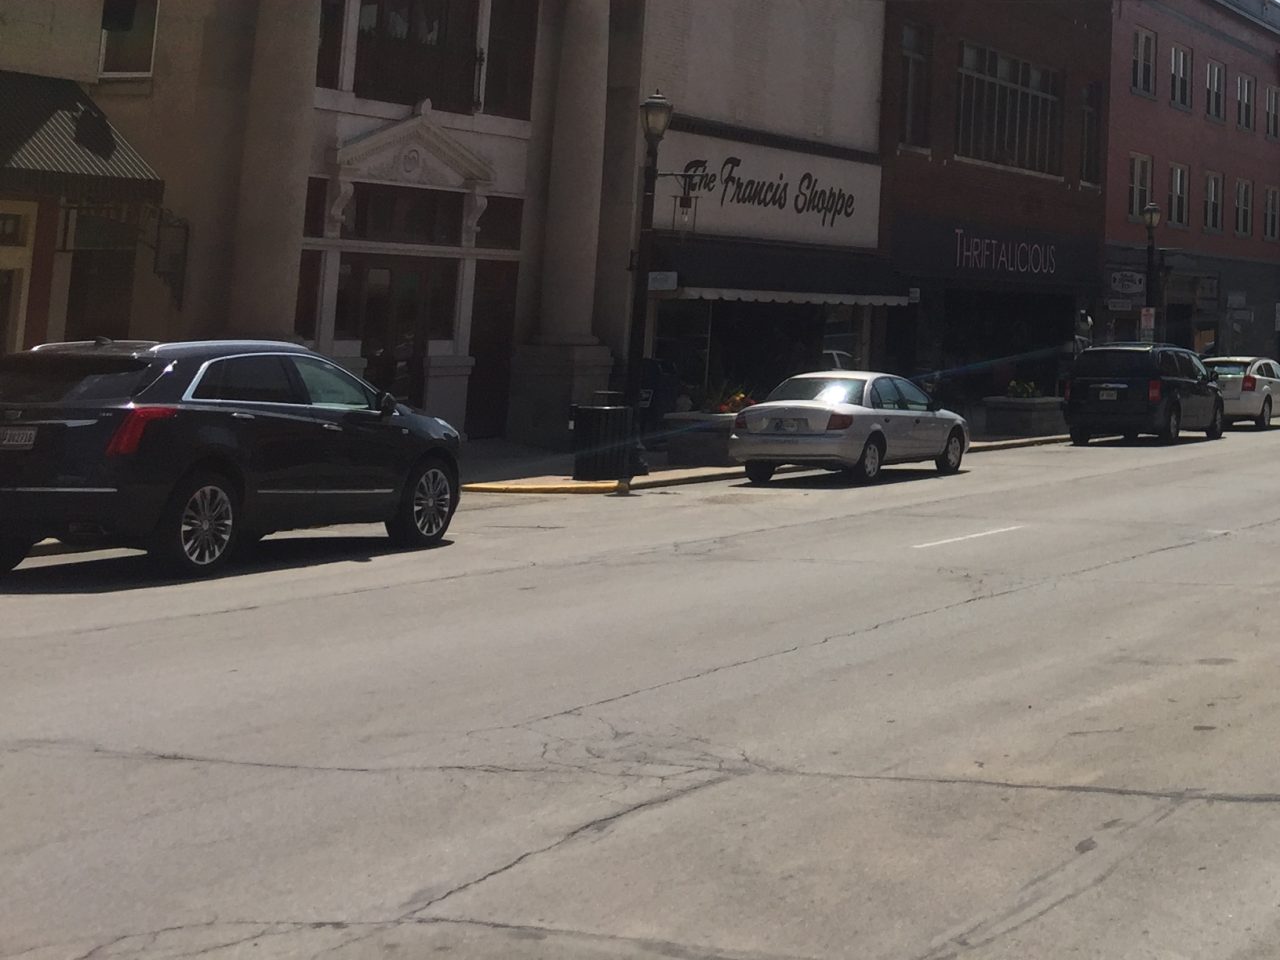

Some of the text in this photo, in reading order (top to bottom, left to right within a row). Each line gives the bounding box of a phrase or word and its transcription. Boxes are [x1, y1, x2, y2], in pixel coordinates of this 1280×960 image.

[684, 156, 856, 227] The Francis Shoppe
[955, 228, 1057, 274] THRIFTALICIOUS
